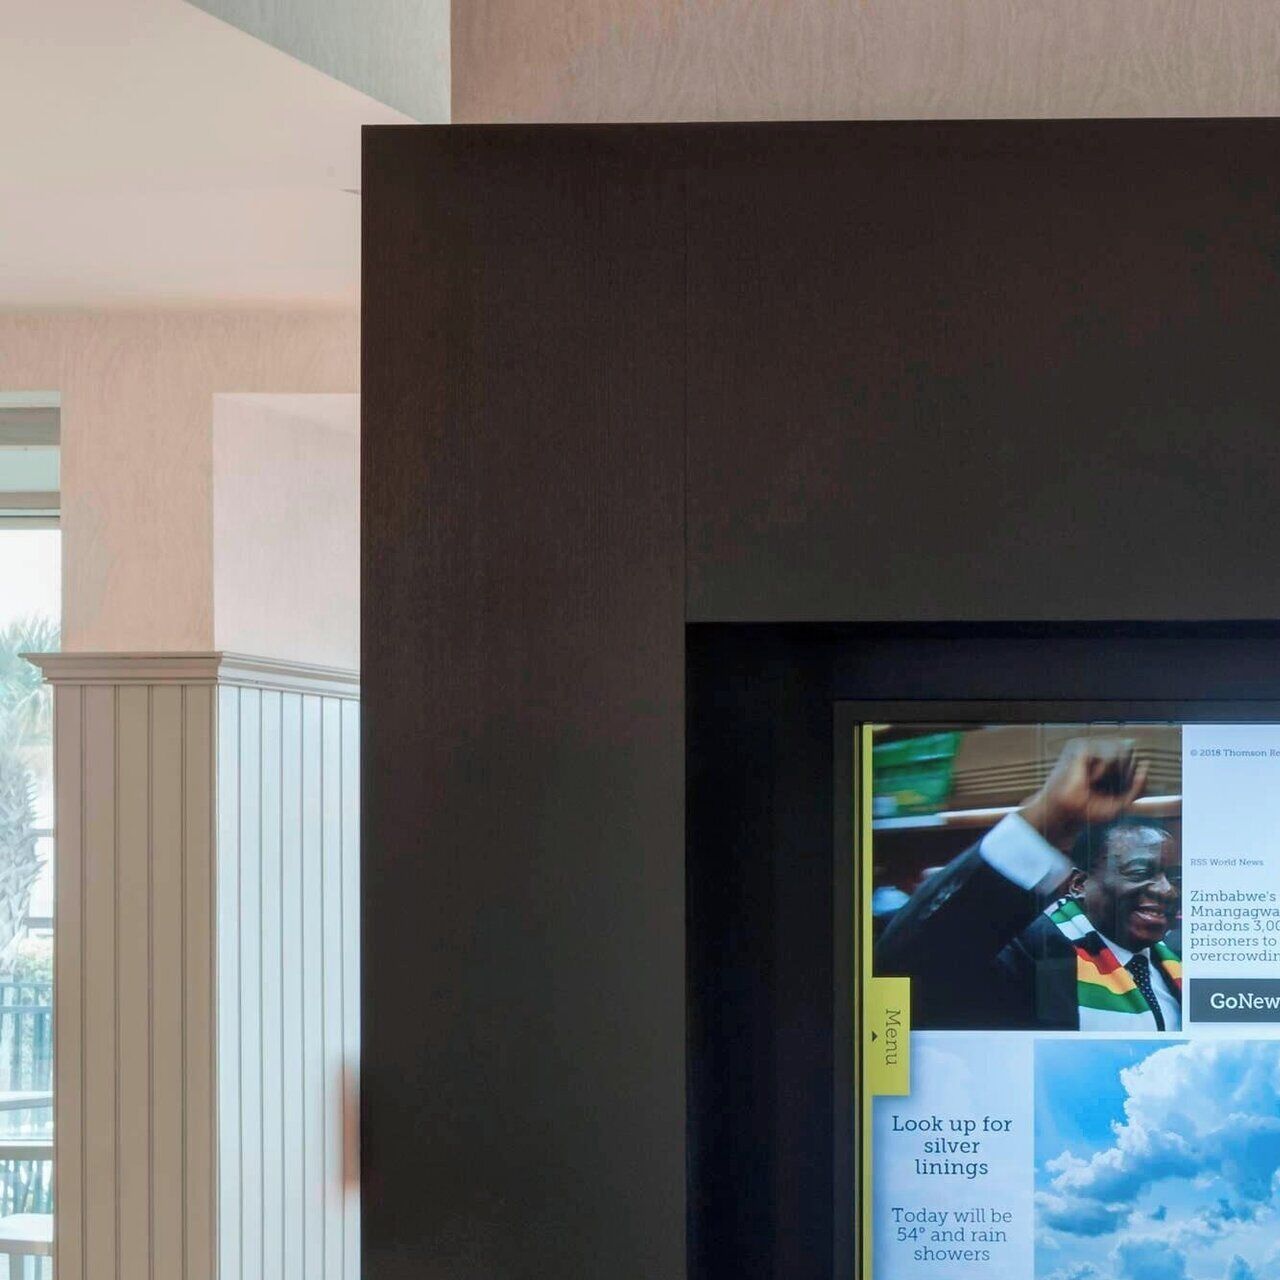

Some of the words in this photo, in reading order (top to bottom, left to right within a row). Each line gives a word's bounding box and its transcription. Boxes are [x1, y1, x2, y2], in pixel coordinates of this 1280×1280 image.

[1200, 749, 1221, 757] 2018
[1223, 748, 1267, 757] Thomson
[1210, 858, 1237, 867] World
[1239, 858, 1264, 867] News
[1190, 889, 1277, 903] Zimbabwe's
[1190, 905, 1280, 920] Mnangagwa
[1190, 919, 1250, 933] pardons
[1190, 935, 1260, 948] prisoners
[1262, 935, 1278, 947] to
[885, 1009, 902, 1065] Menu
[892, 1116, 943, 1131] Look
[949, 1119, 977, 1135] up
[983, 1116, 1013, 1131] for
[924, 1138, 980, 1153] silver
[915, 1159, 988, 1179] linings
[892, 1208, 949, 1226] Today
[953, 1208, 986, 1223] will
[990, 1208, 1012, 1223] be
[897, 1227, 925, 1242] 54°
[931, 1227, 965, 1242] and
[971, 1227, 1007, 1242] rain
[914, 1246, 990, 1261] showers
